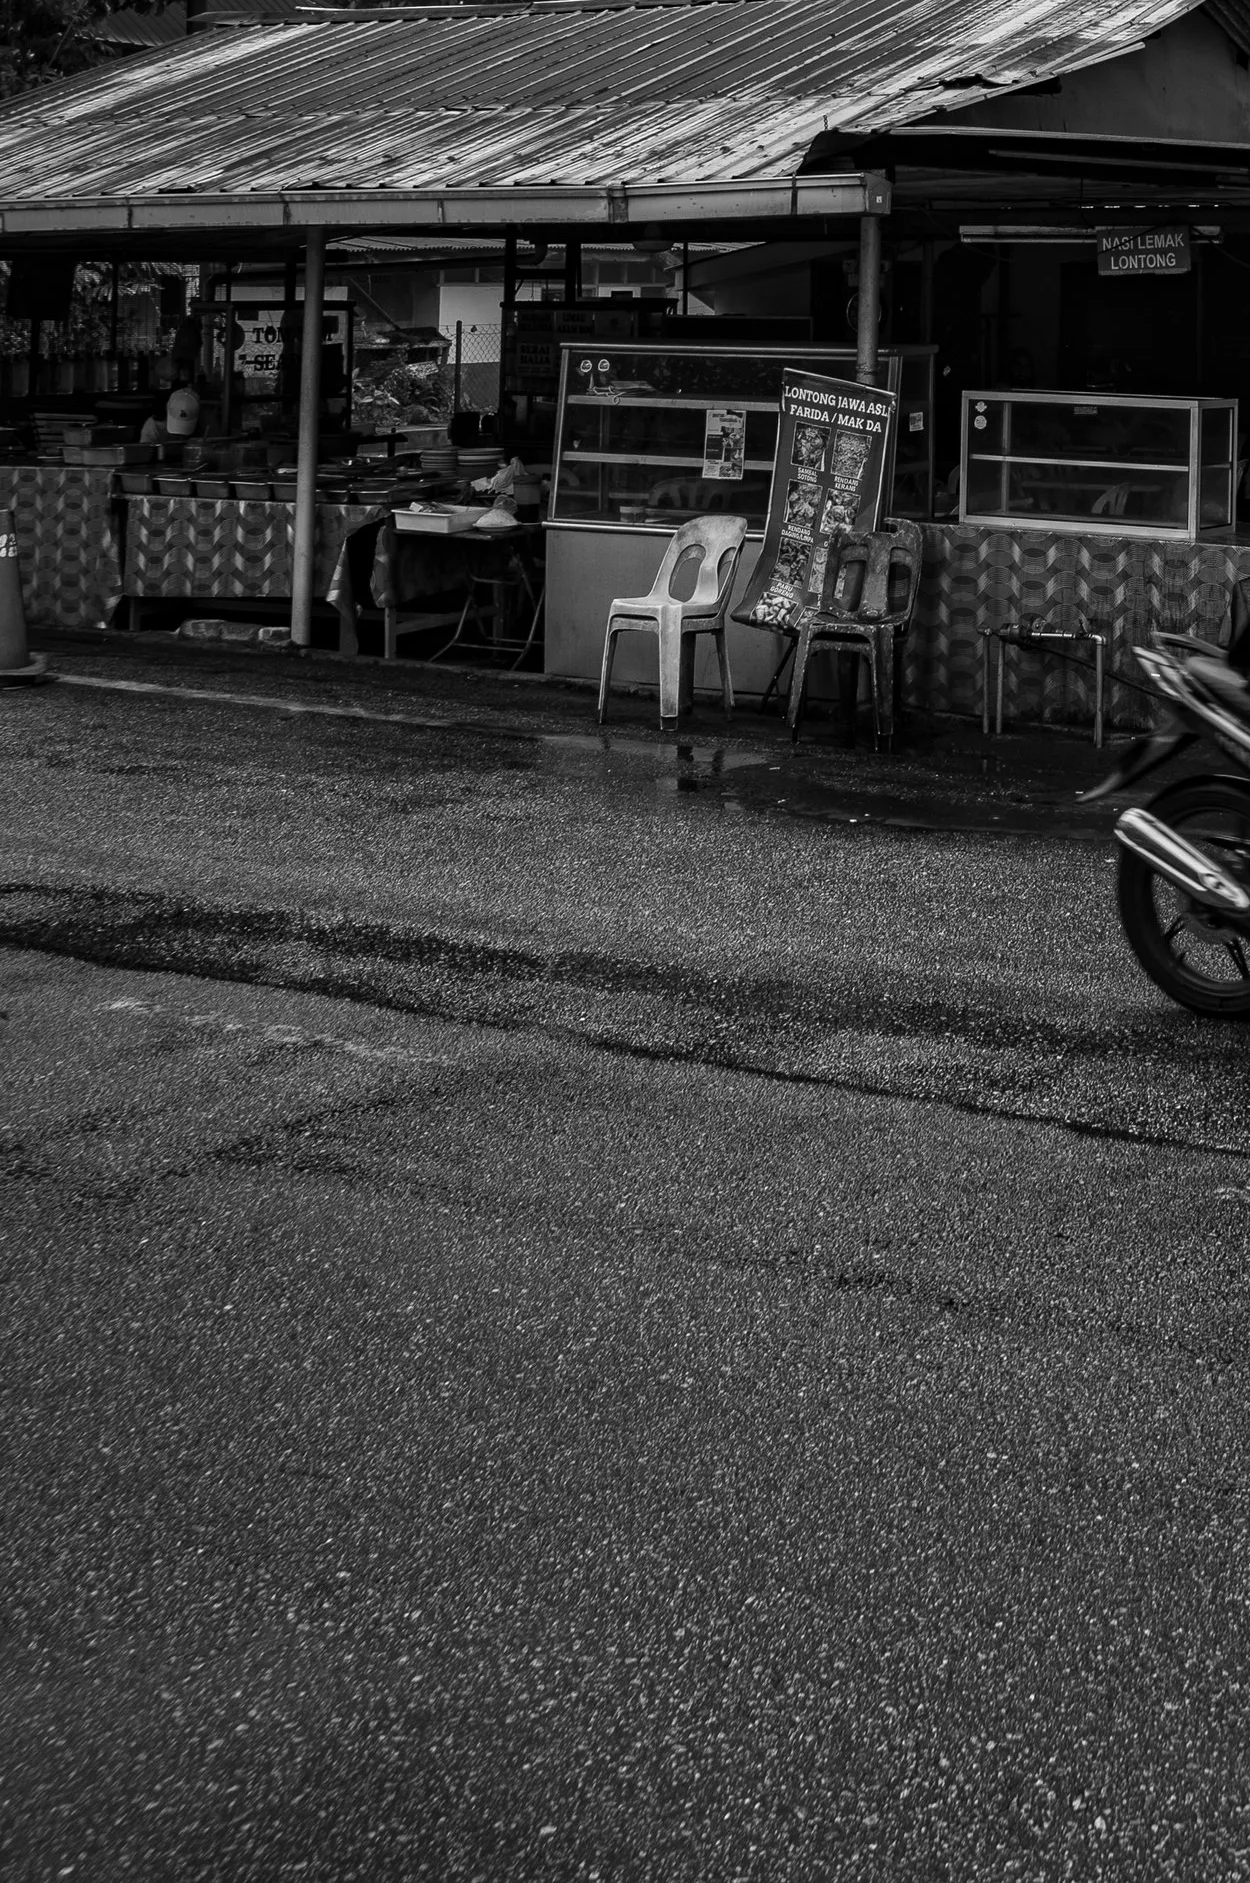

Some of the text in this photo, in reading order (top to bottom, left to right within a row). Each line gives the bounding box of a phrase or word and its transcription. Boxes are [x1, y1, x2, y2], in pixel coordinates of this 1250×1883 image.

[1138, 234, 1184, 249] LEMAK
[1111, 253, 1176, 270] LONTONG
[784, 386, 836, 406] LONTONG
[837, 396, 866, 413] JAWA
[790, 404, 830, 423] FARIDA
[837, 414, 865, 430] MAK
[865, 419, 882, 433] DA
[797, 473, 817, 483] SOTONG
[834, 476, 859, 487] RENDANG
[769, 586, 794, 599] GORENG
